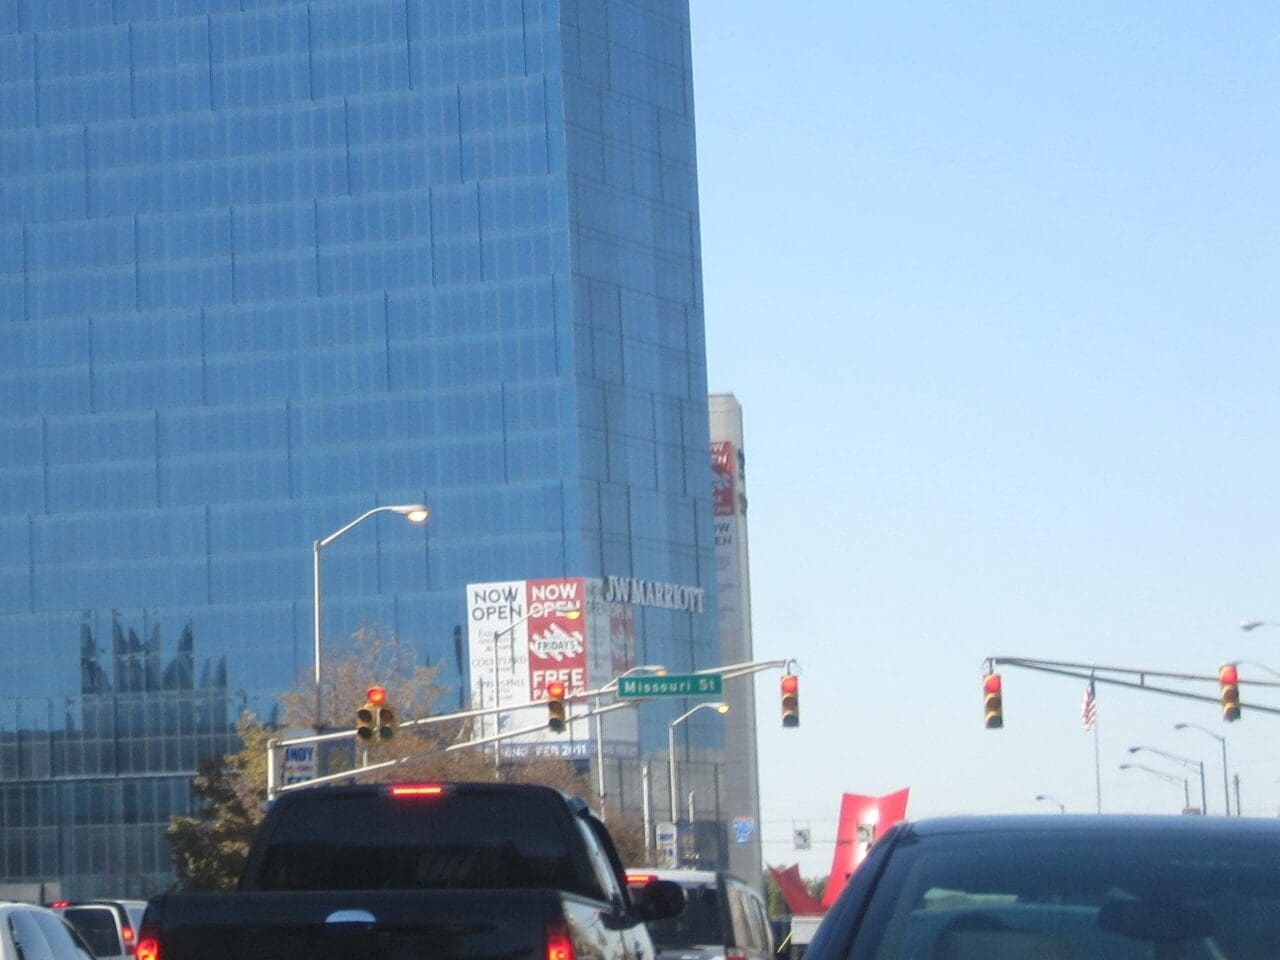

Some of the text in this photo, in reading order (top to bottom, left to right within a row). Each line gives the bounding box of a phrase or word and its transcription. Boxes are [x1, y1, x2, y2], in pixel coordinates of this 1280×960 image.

[474, 587, 519, 604] NOW
[531, 582, 577, 601] NOW
[606, 575, 631, 602] JW
[631, 578, 705, 613] MARRIOTT
[472, 604, 522, 621] OPEN
[532, 669, 585, 688] FREE
[624, 678, 715, 694] Missouri St
[532, 686, 585, 700] PAING
